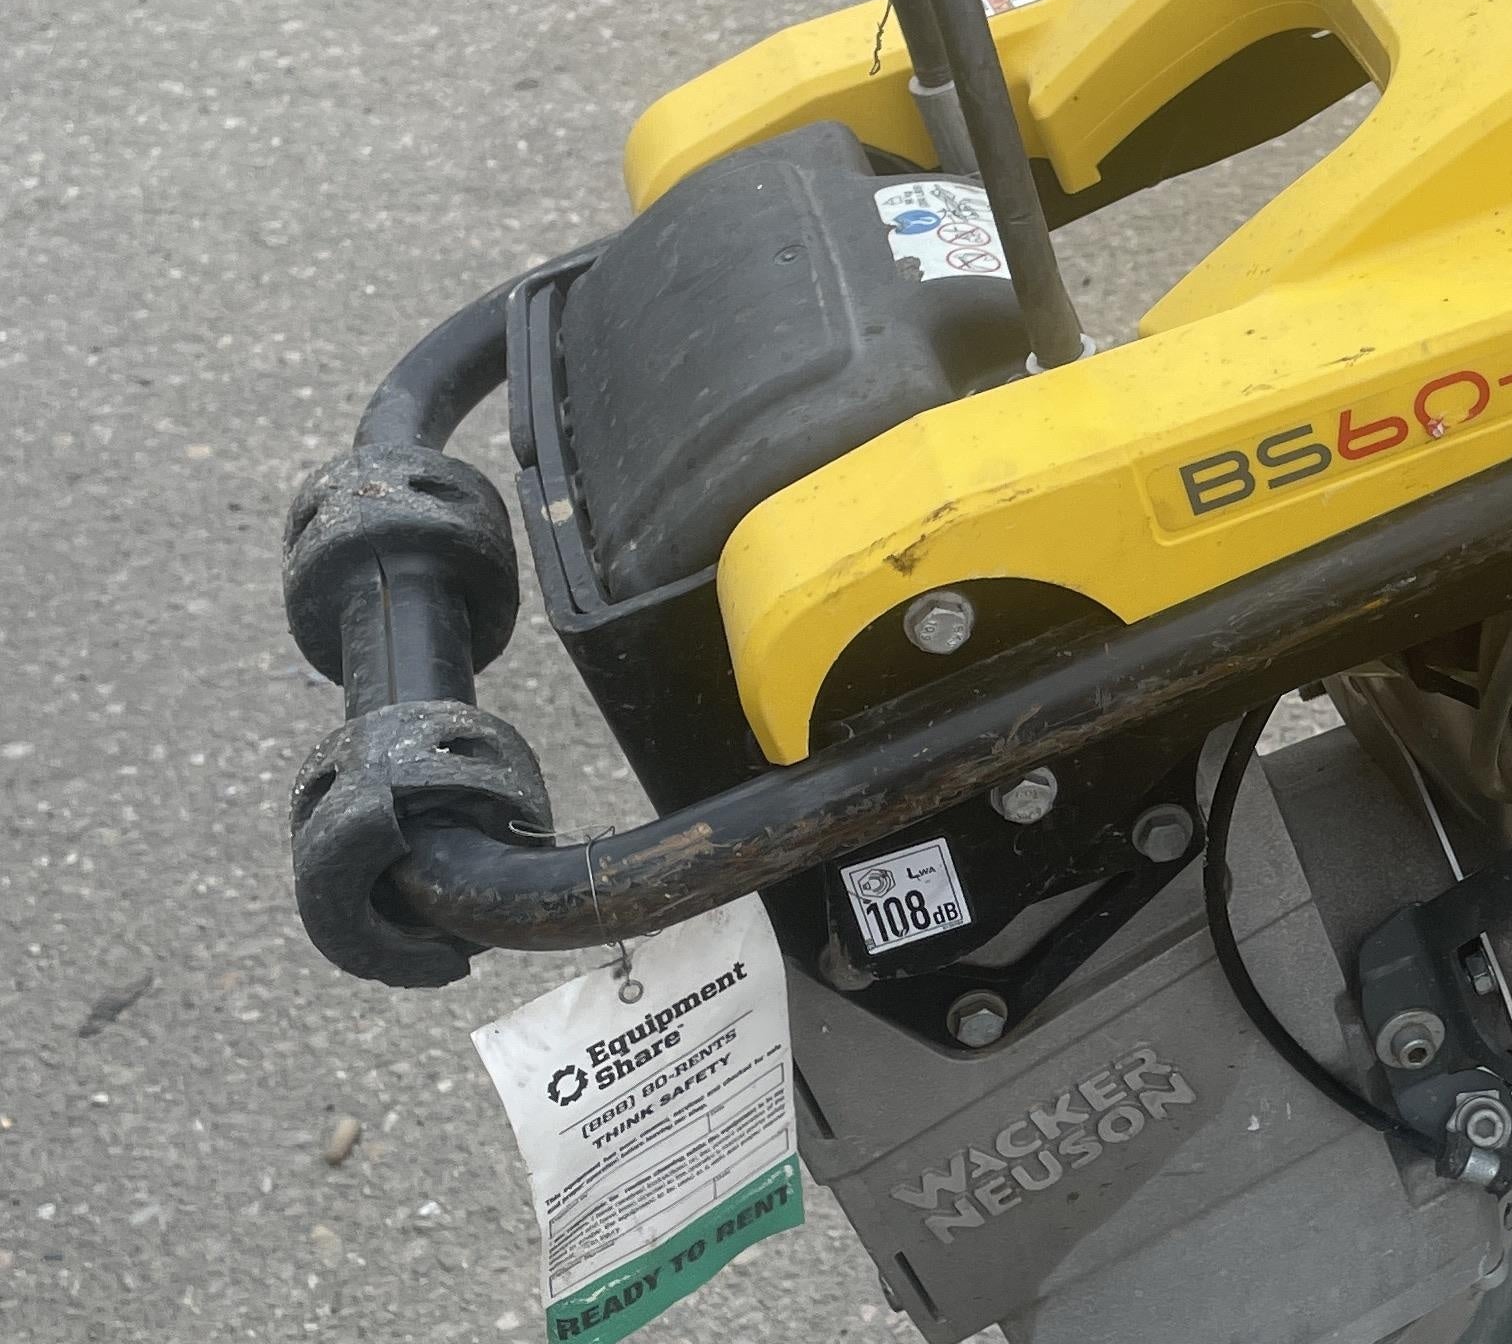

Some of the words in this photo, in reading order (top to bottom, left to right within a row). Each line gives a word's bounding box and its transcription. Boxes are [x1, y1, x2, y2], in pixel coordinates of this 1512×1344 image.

[866, 889, 931, 942] 108
[932, 901, 959, 925] dB
[585, 960, 748, 1069] Equipment
[594, 1030, 681, 1091] Share
[581, 1094, 637, 1140] (888)
[641, 1028, 738, 1099] 80-RENTS
[592, 1104, 656, 1150] THINK
[659, 1052, 732, 1107] SAFETY
[891, 1048, 1172, 1210] WACKER
[924, 1070, 1197, 1244] NEUSON
[555, 1265, 663, 1341] READY
[669, 1238, 708, 1274] TO
[716, 1183, 791, 1244] RENT
